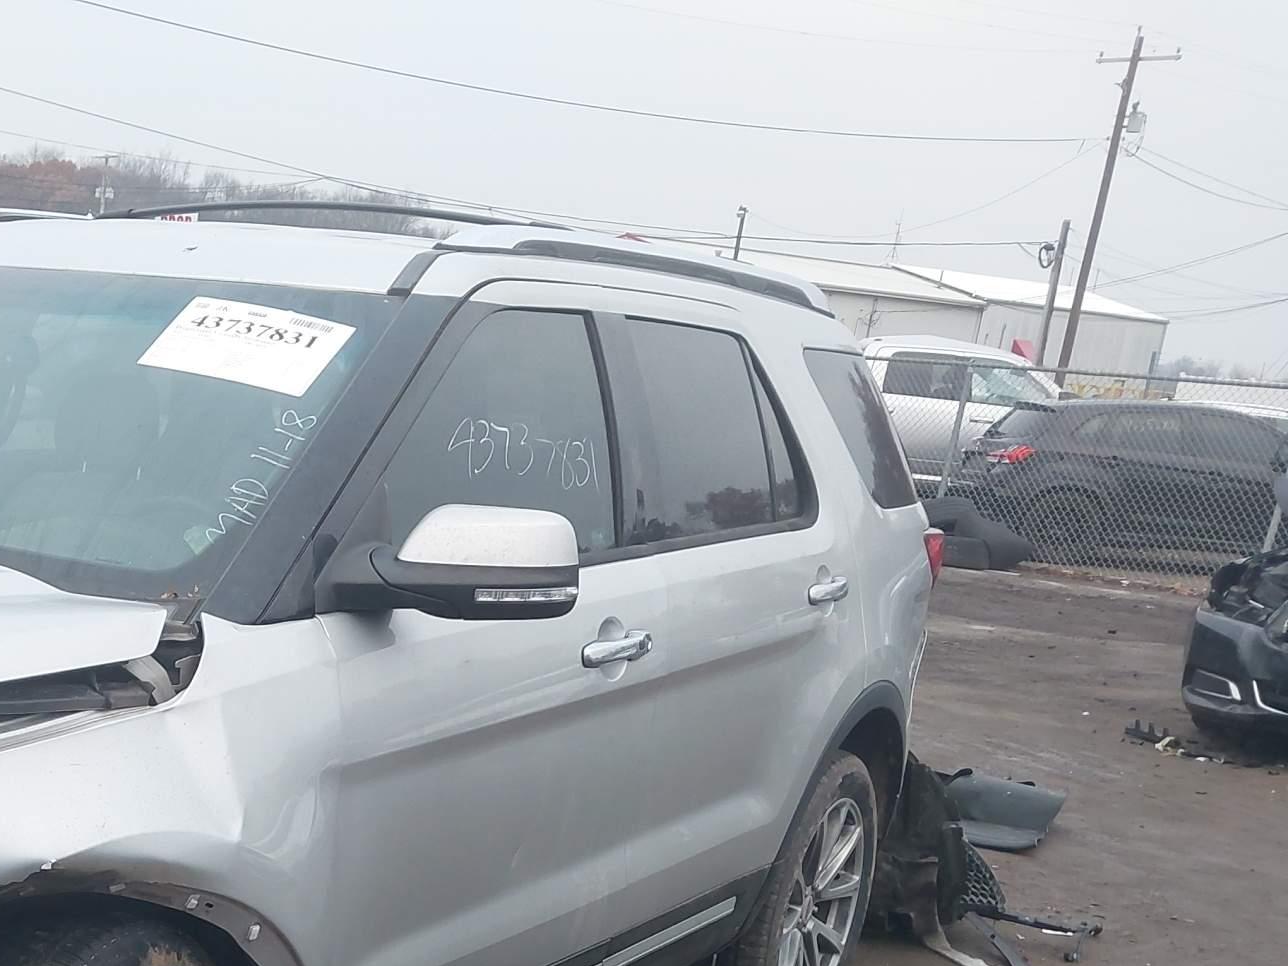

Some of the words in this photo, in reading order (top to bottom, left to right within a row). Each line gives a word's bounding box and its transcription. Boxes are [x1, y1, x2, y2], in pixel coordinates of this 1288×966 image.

[190, 314, 319, 349] 43737831
[205, 478, 269, 544] MAD
[250, 409, 318, 470] 11-18
[447, 417, 600, 493] 43737831
